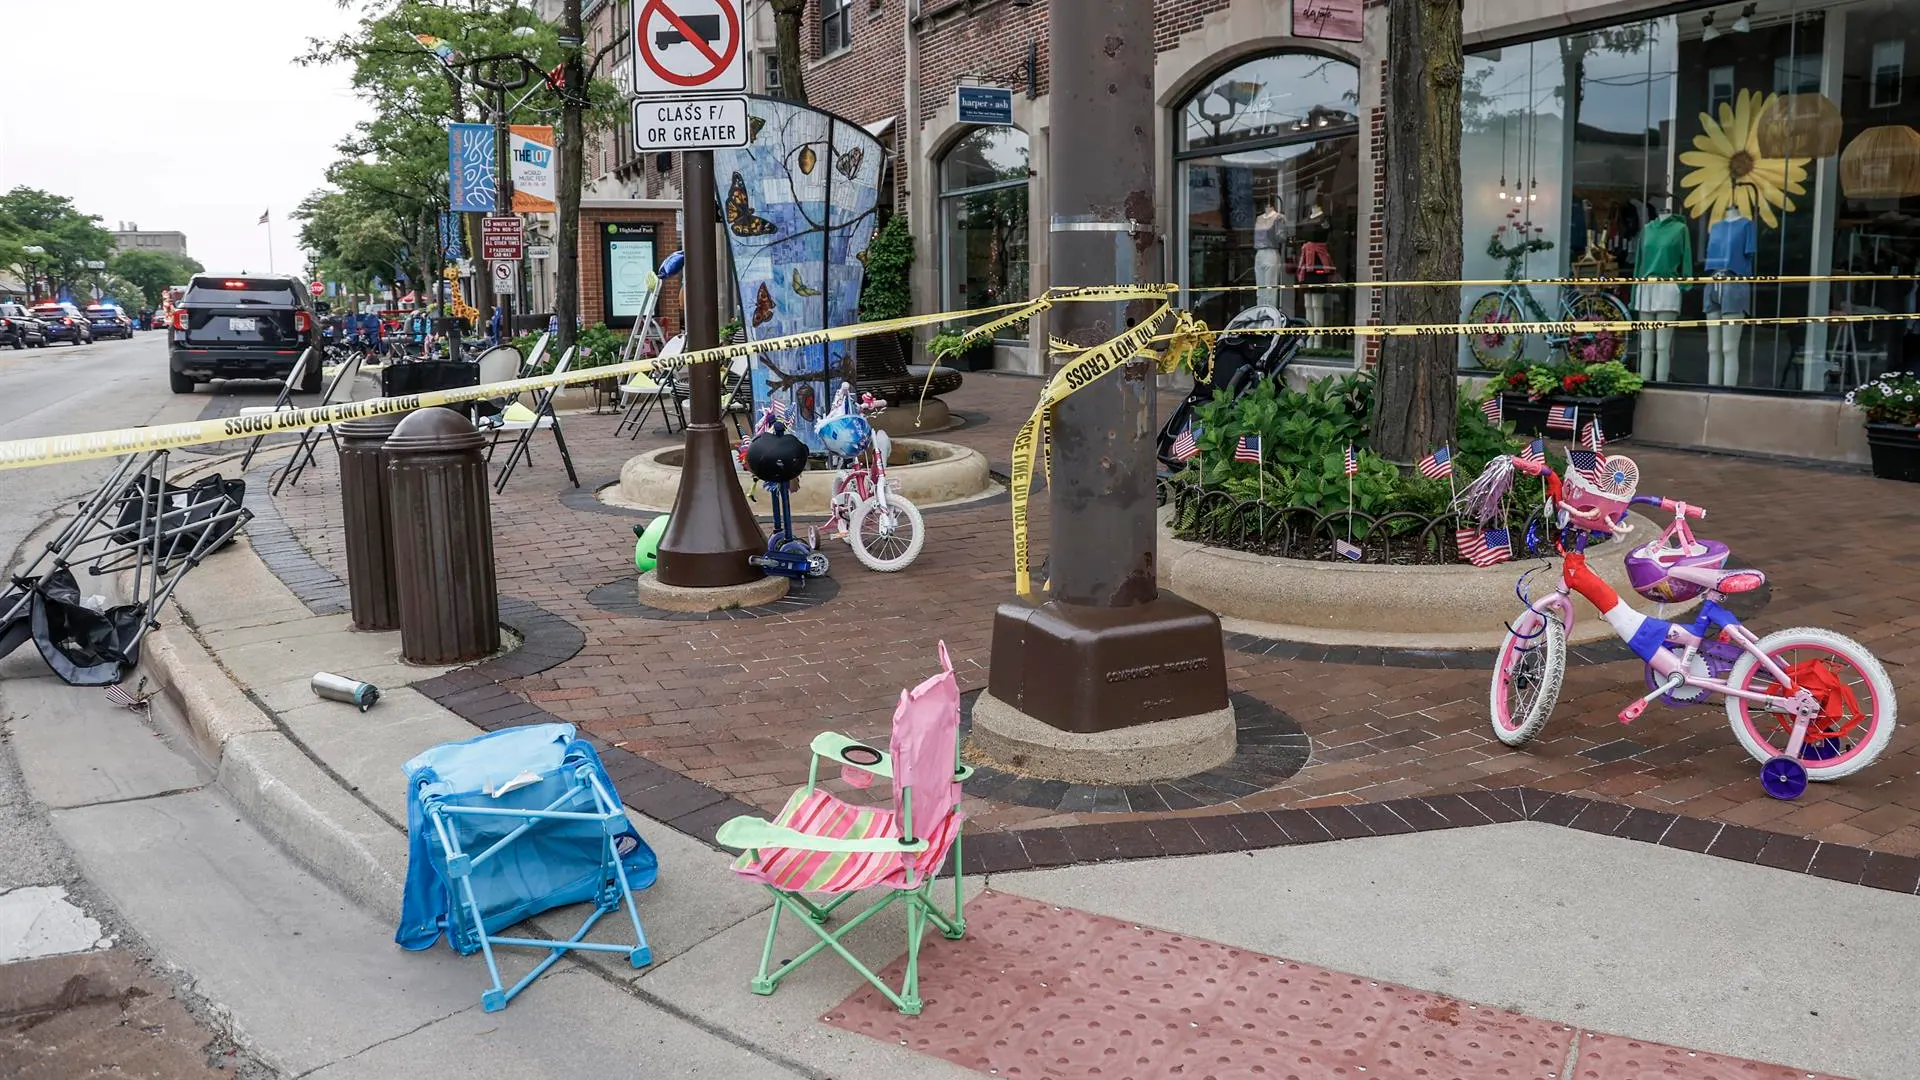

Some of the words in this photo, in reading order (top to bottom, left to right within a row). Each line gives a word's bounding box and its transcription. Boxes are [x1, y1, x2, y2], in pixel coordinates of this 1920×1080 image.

[962, 97, 988, 109] harper
[995, 99, 1009, 109] ash
[658, 106, 702, 122] CLASS
[648, 128, 666, 142] OR
[674, 125, 736, 141] GREATER
[1137, 328, 1153, 345] DO
[1416, 327, 1459, 336] POLICE
[1463, 326, 1488, 335] LINE
[1494, 325, 1510, 335] DO
[1514, 324, 1535, 334] NOT
[1539, 323, 1577, 334] CROSS
[752, 341, 781, 355] LINE
[784, 332, 831, 349] POLICE
[700, 351, 725, 363] NOT
[730, 347, 748, 360] DO
[1109, 338, 1138, 365] NOT
[651, 354, 695, 373] CROSS
[1066, 353, 1110, 390] CROSS
[336, 404, 366, 420] LINE
[371, 395, 420, 414] POLICE
[278, 412, 306, 428] NOT
[310, 408, 329, 423] DO
[225, 414, 273, 436] CROSS
